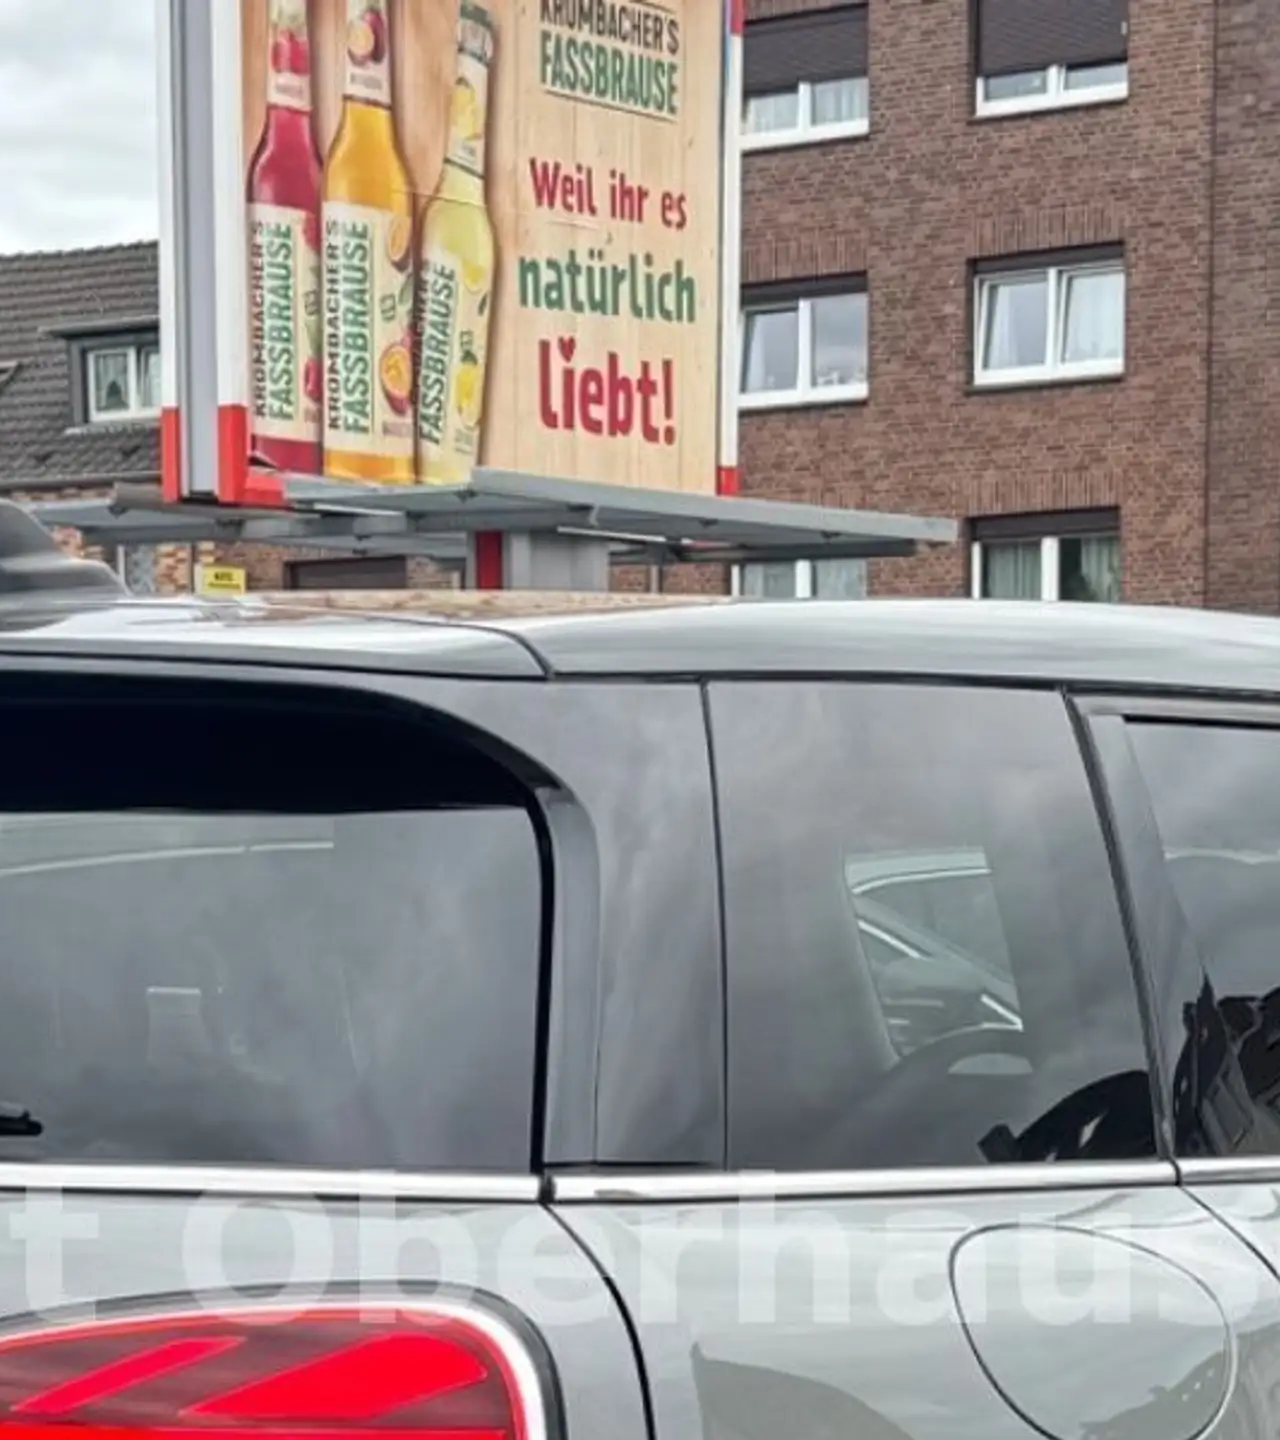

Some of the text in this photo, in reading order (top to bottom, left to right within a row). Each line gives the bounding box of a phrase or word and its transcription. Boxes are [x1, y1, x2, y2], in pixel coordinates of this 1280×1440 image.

[540, 0, 680, 57] KROMBACHER'S
[540, 29, 679, 115] FASSBRAUSE
[528, 156, 688, 231] Weil ihr es
[266, 223, 294, 422] FASSBRAUSE
[342, 220, 371, 435] FASSBRAUSE
[518, 249, 696, 324] natürlich
[419, 263, 456, 446] FASSBRAUSE
[538, 336, 677, 446] liebt!
